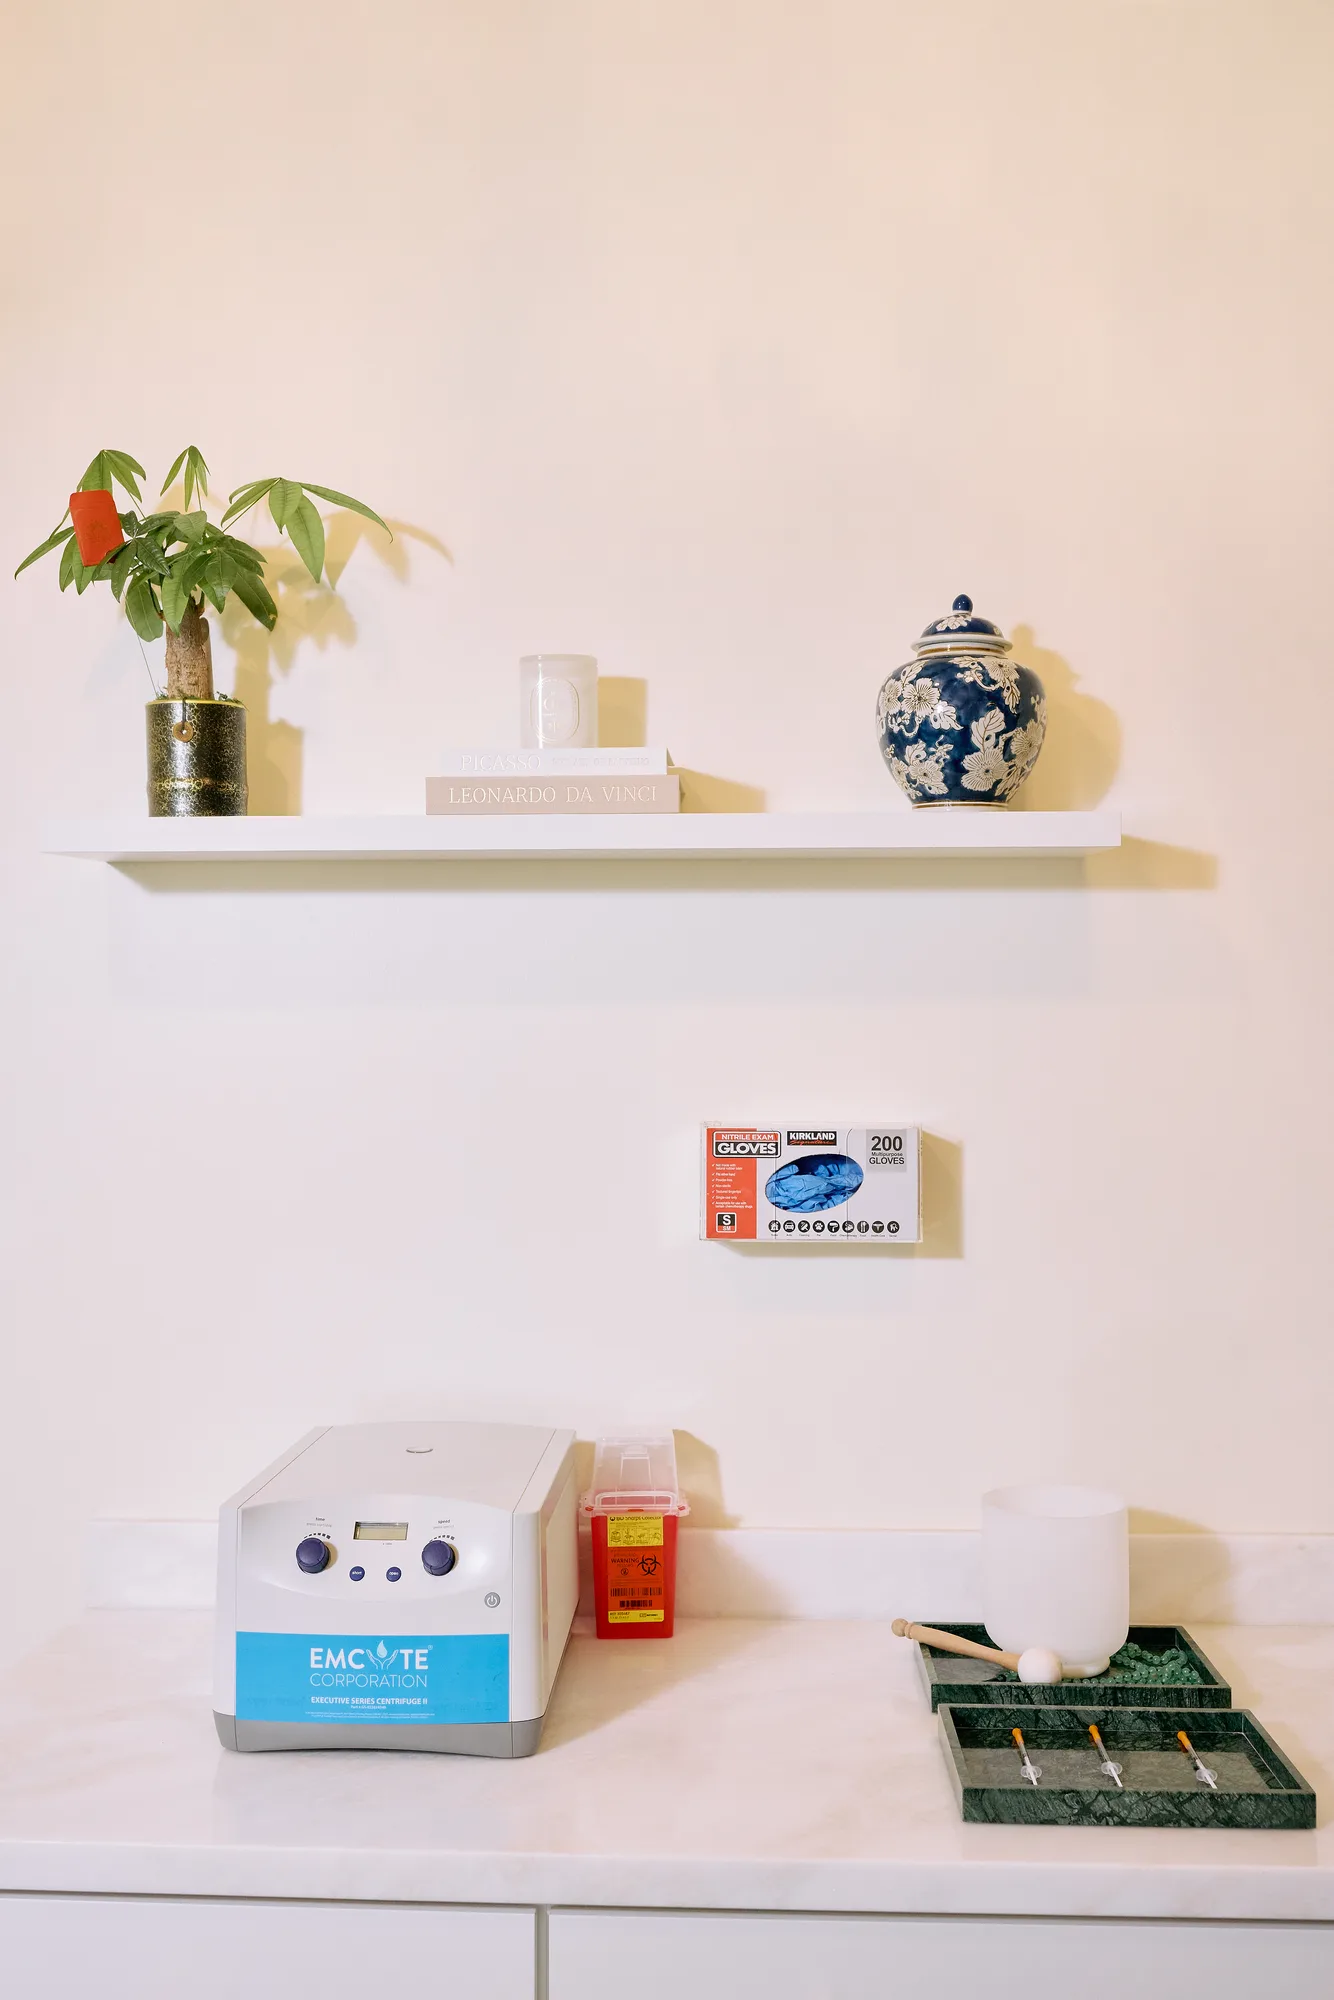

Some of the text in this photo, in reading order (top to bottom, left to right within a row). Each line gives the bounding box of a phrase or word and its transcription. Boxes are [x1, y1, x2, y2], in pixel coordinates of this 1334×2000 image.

[460, 754, 541, 771] PICASSO
[449, 785, 656, 804] LEONARDO DA VINCI
[789, 1132, 836, 1140] KIRKLAND
[717, 1142, 777, 1154] GLOVES
[871, 1135, 903, 1151] 200
[869, 1157, 905, 1165] GLOVES
[722, 1214, 731, 1226] S
[309, 1673, 428, 1688] CORPORATION
[310, 1696, 350, 1705] EXECUTIVE
[351, 1697, 375, 1705] SERIES
[376, 1697, 421, 1706] CENTRIFUGE
